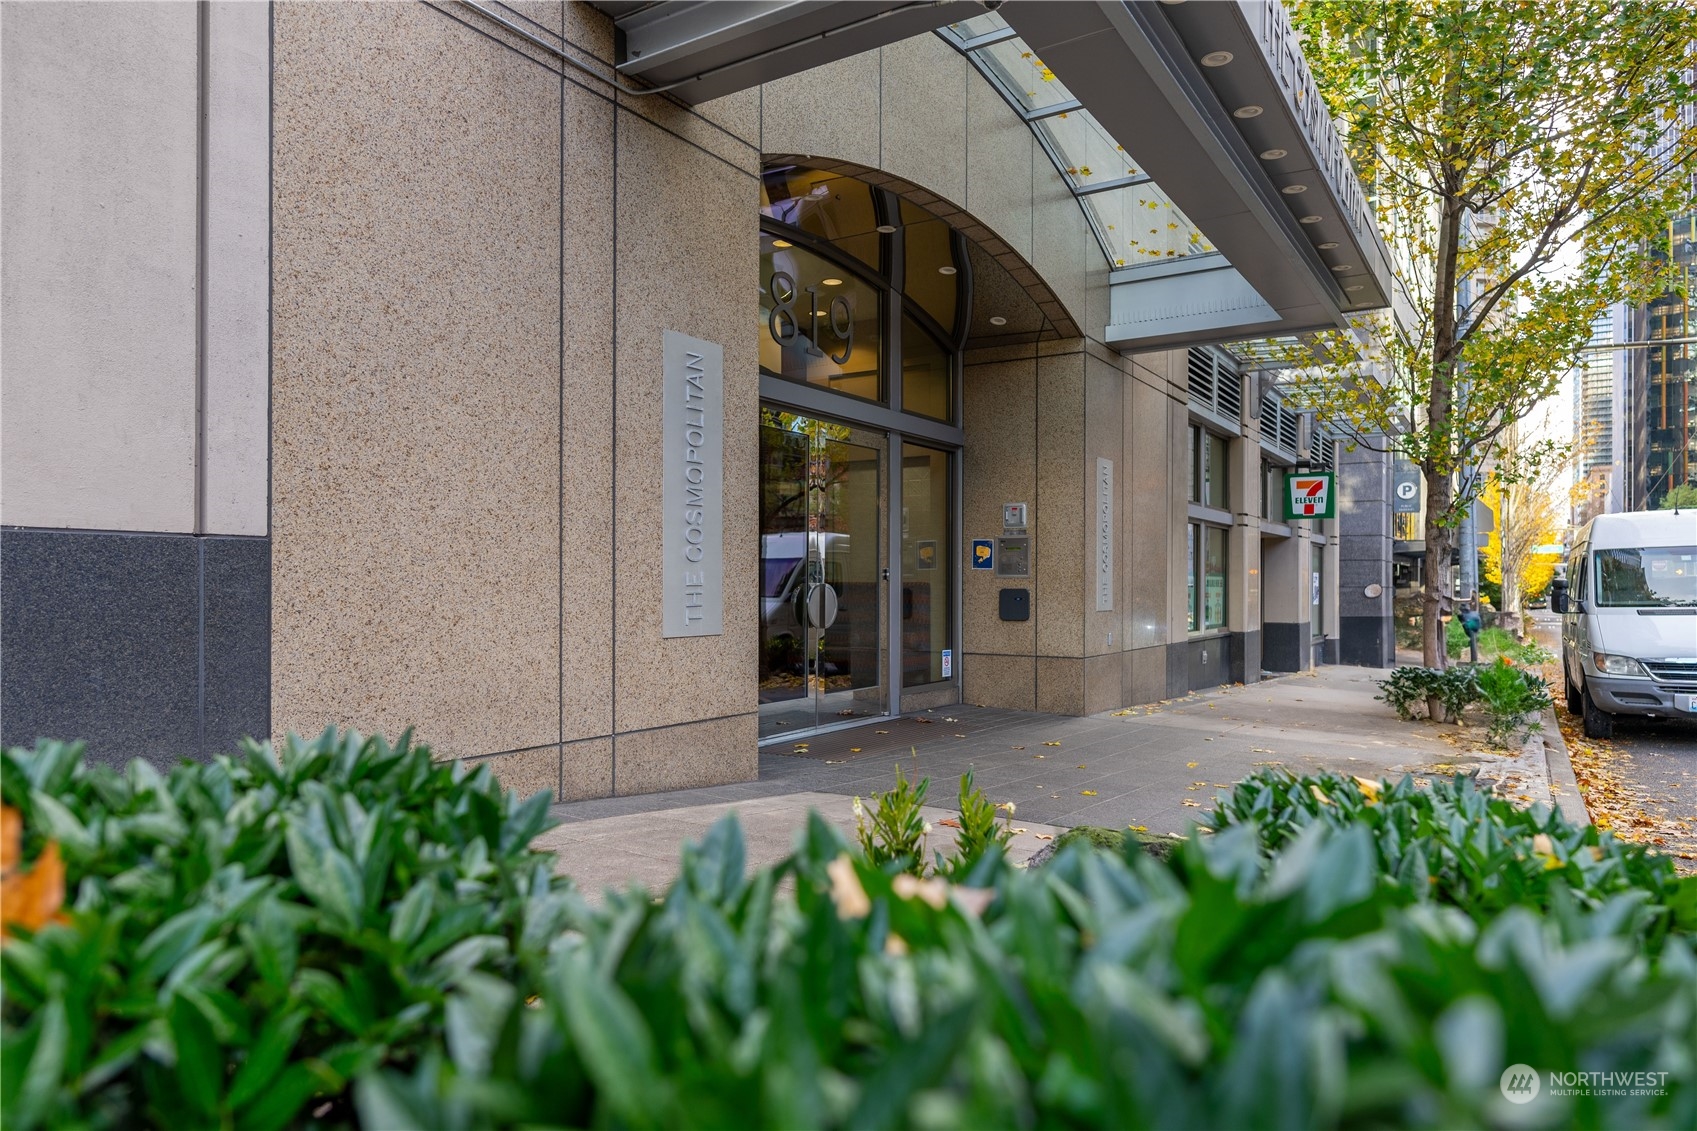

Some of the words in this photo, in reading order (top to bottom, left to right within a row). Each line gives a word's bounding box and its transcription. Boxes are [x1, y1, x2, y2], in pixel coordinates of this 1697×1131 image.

[769, 271, 854, 364] 819
[685, 351, 704, 563] COSMOPOLITAN
[1296, 480, 1323, 514] 7
[1402, 485, 1412, 496] P
[686, 571, 703, 626] THE
